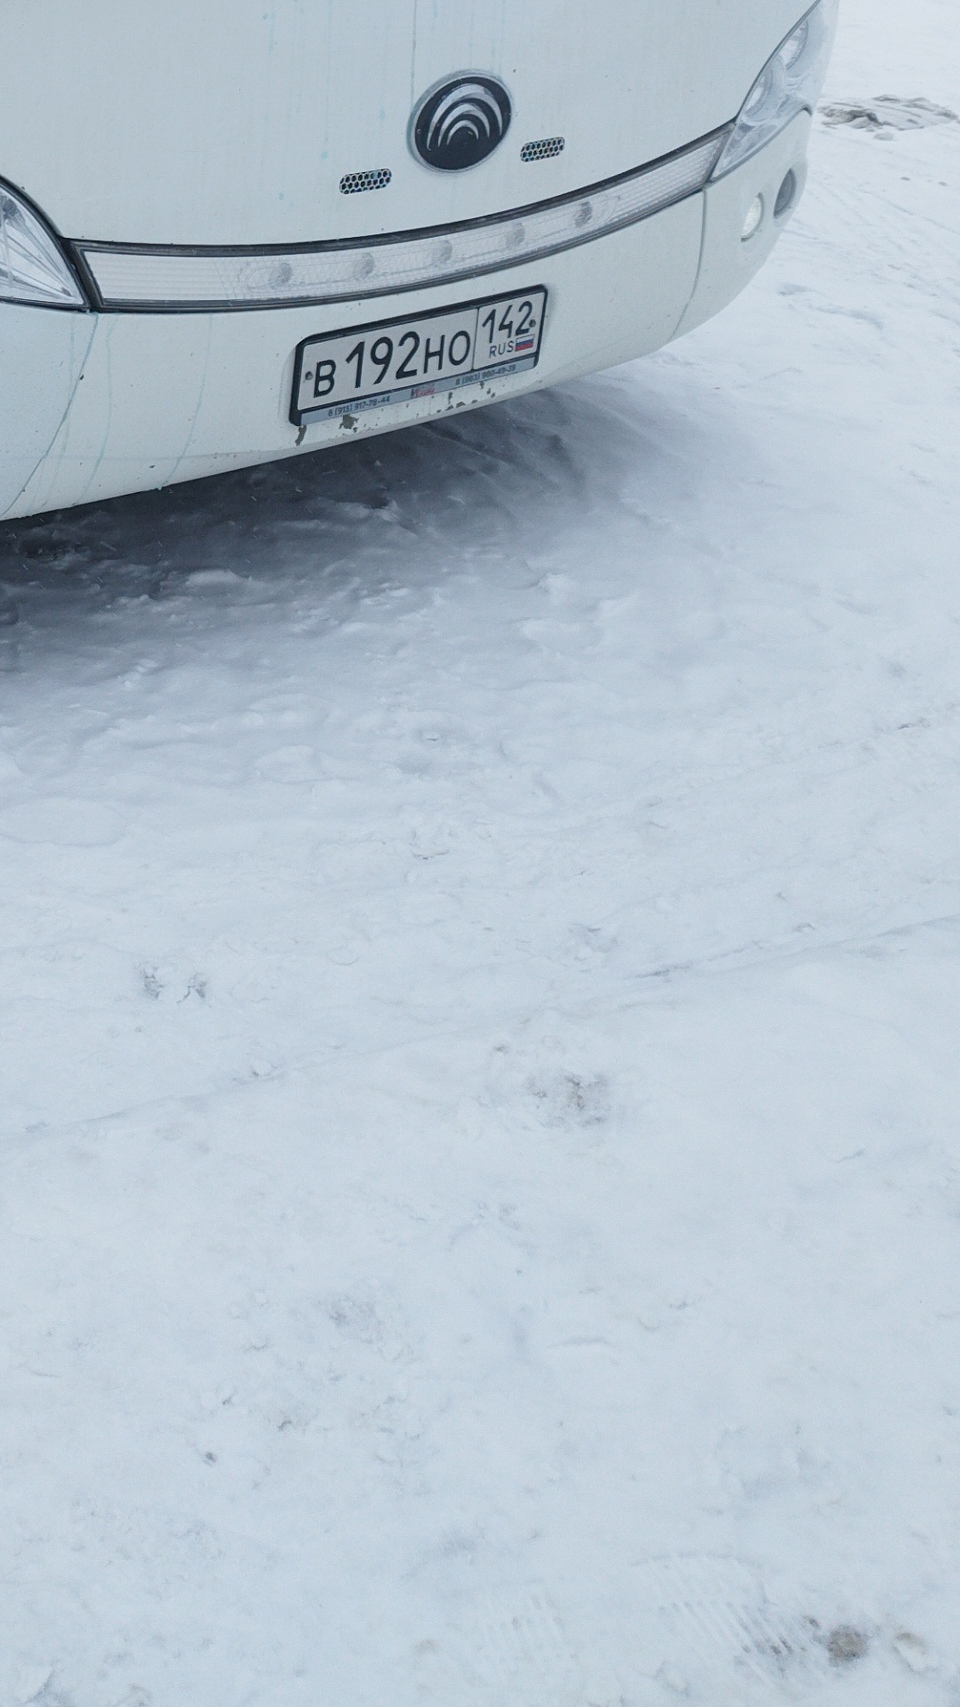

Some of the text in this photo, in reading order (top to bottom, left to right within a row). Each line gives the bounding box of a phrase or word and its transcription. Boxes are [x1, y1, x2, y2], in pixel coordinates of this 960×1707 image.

[481, 300, 534, 344] 142
[313, 330, 472, 399] В192НО
[489, 340, 515, 360] RUS
